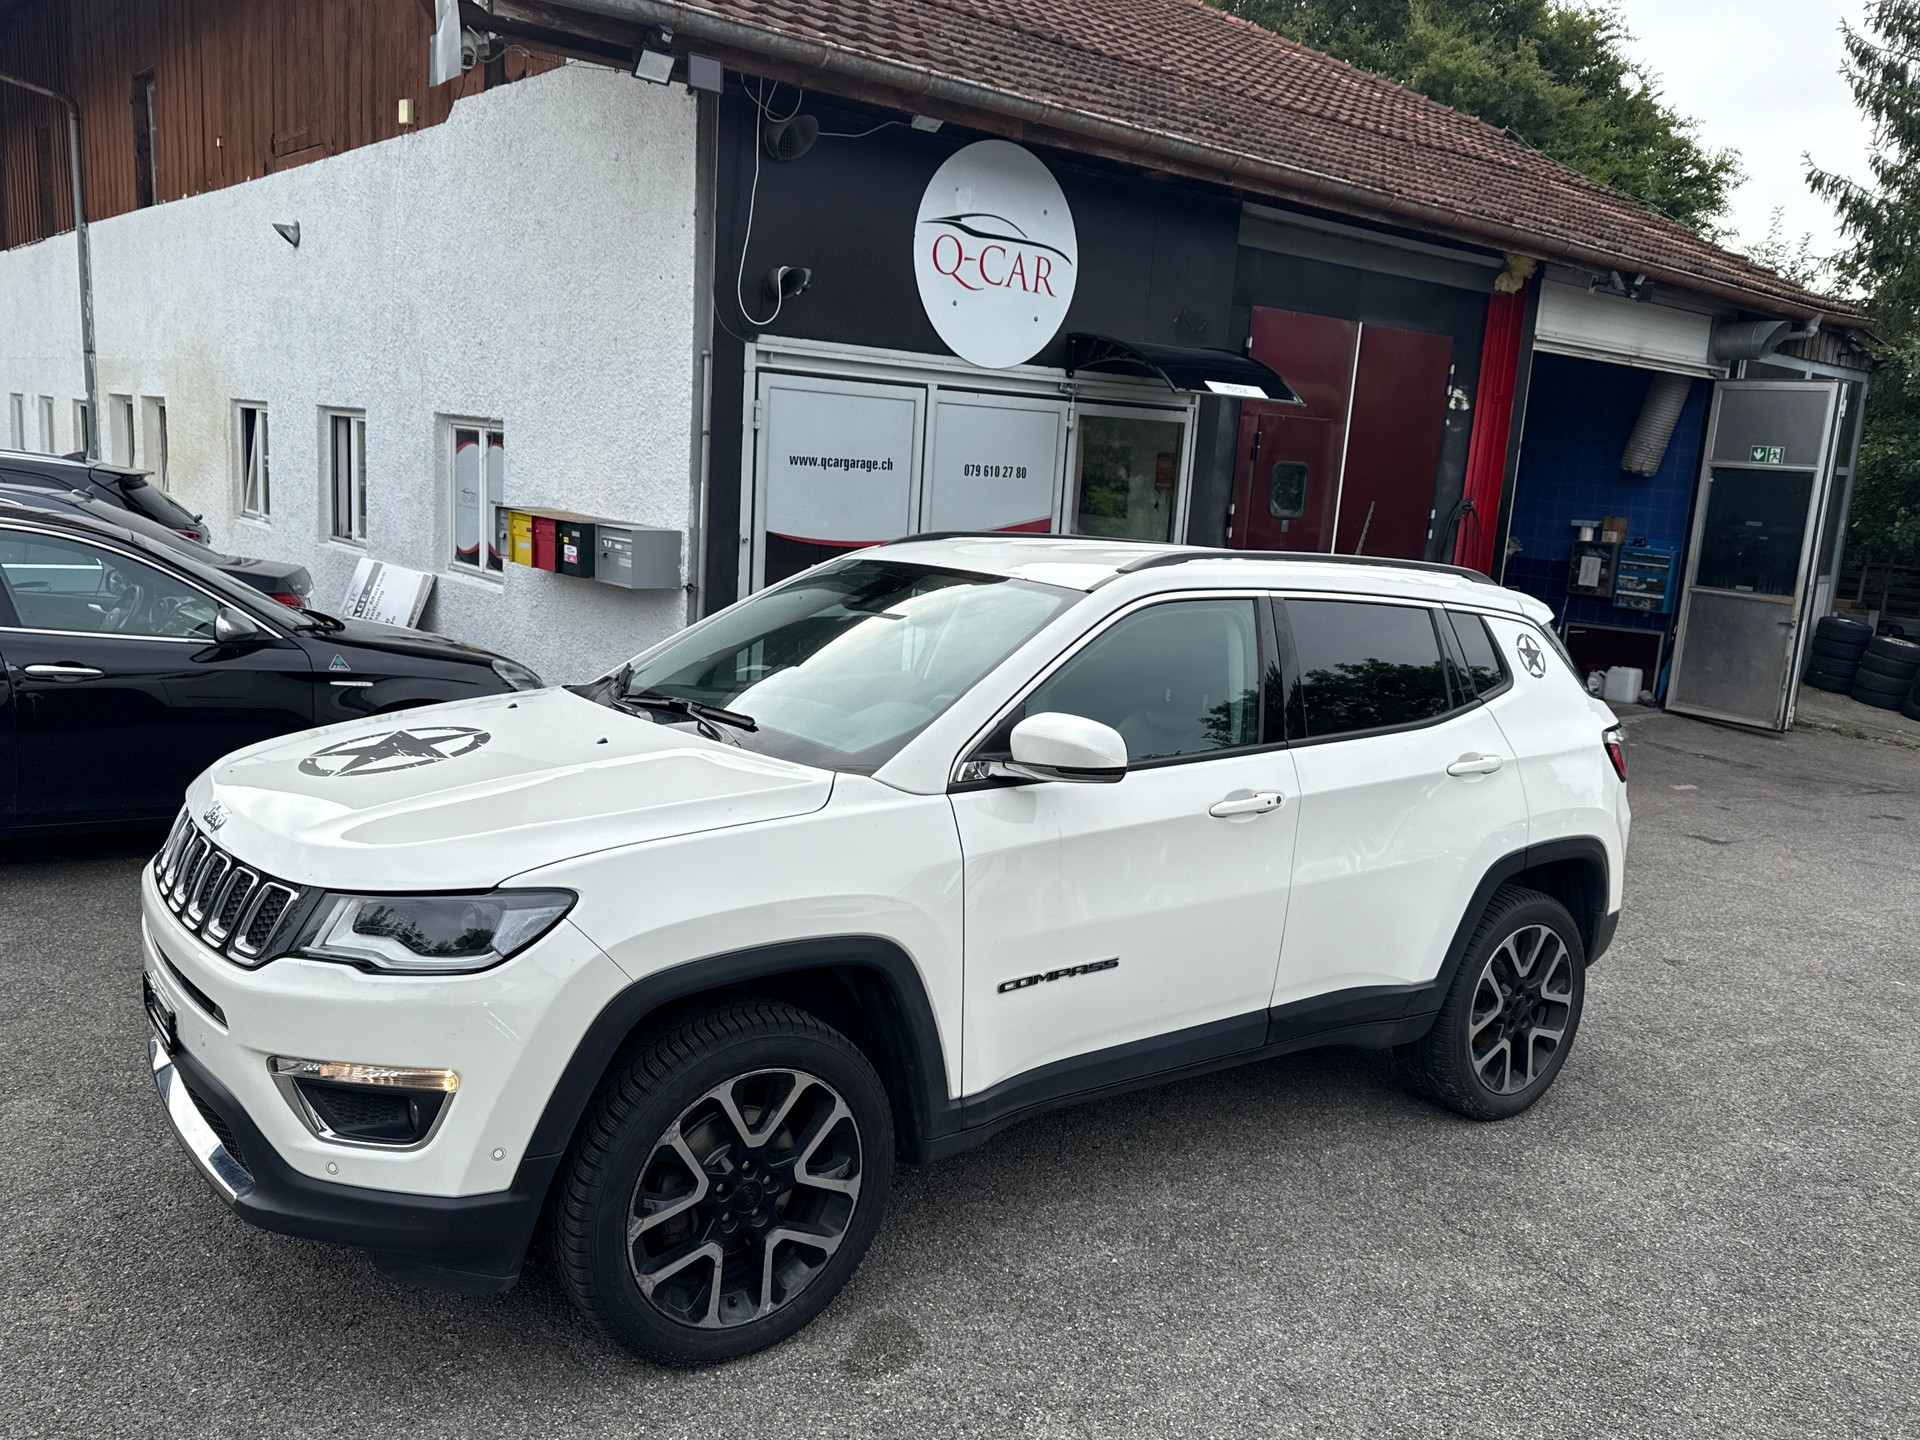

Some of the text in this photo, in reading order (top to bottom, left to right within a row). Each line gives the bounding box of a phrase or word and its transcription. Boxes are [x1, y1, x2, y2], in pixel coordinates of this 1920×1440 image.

[932, 234, 1057, 298] Q-CAR
[789, 455, 893, 473] www.qcargarage.ch
[964, 464, 1027, 479] 079 610 27 80
[997, 957, 1119, 993] COMPASS
